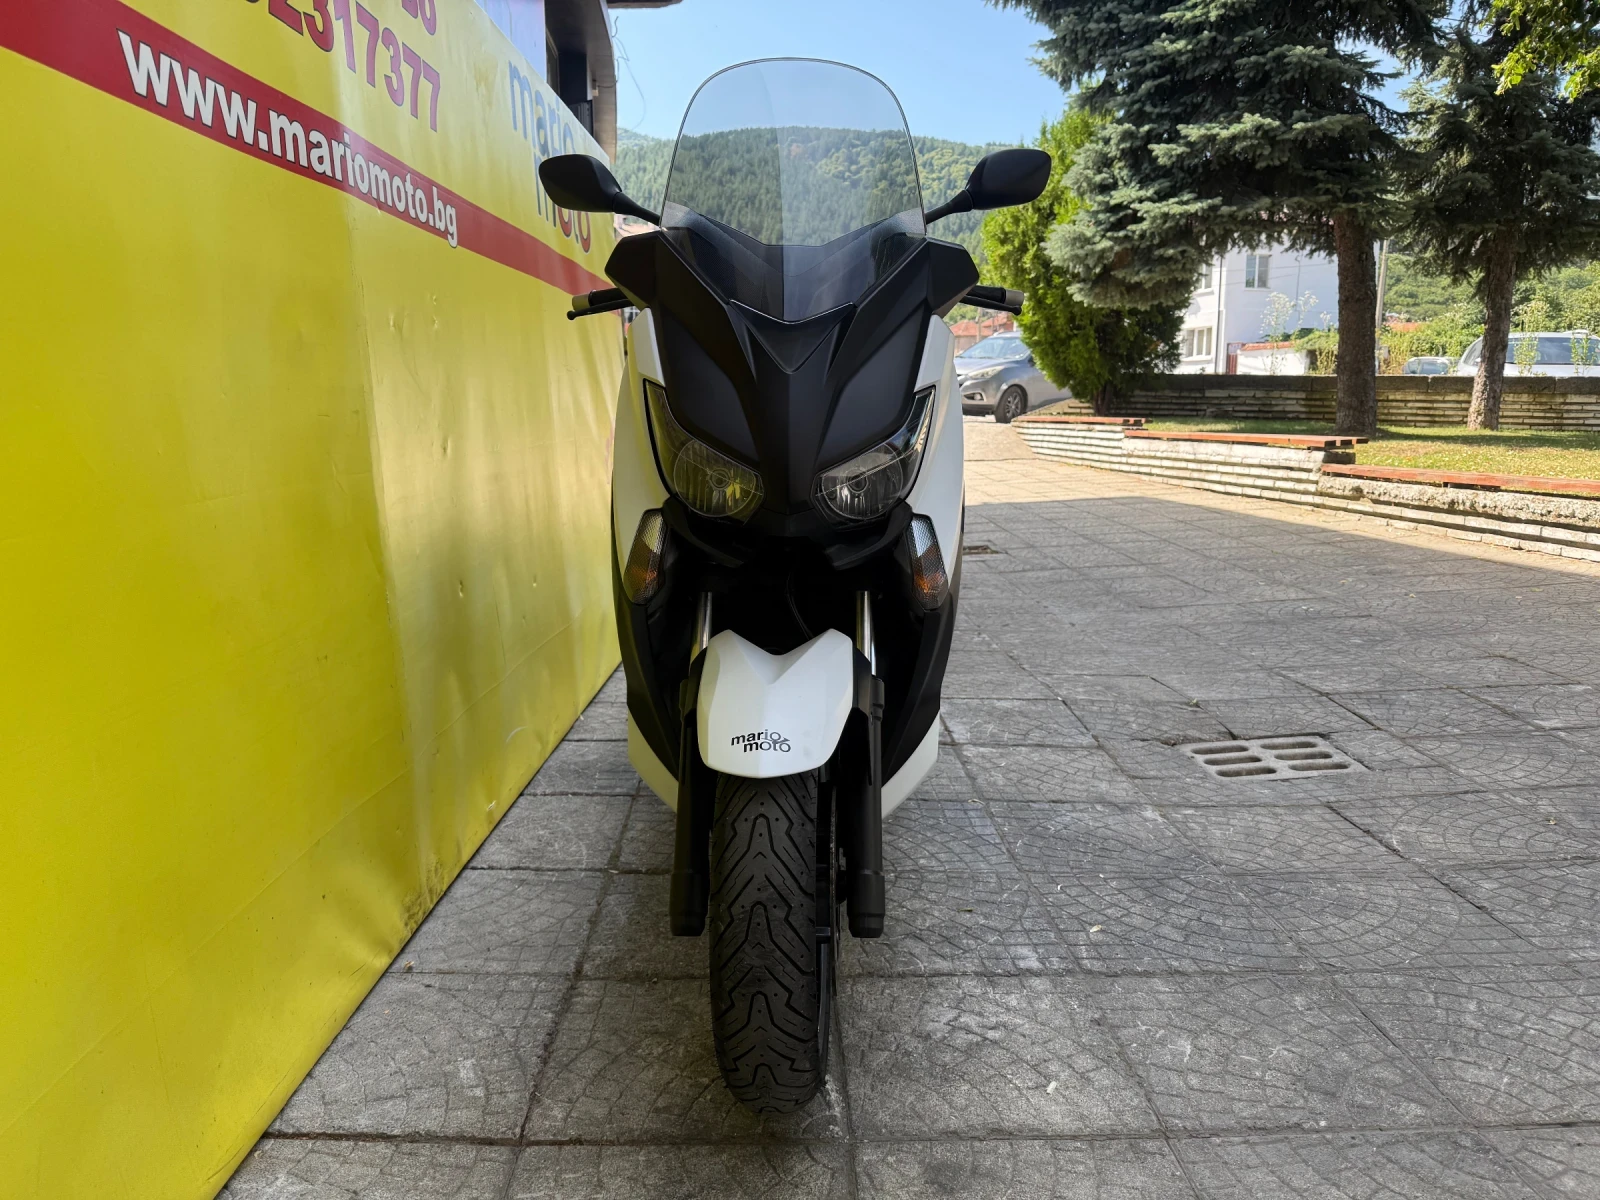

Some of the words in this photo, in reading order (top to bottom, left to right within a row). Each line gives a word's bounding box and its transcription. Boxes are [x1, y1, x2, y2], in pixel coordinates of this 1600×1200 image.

[116, 28, 458, 248] www.mariomoto.bg
[731, 729, 782, 746] mario
[743, 740, 791, 753] moto
